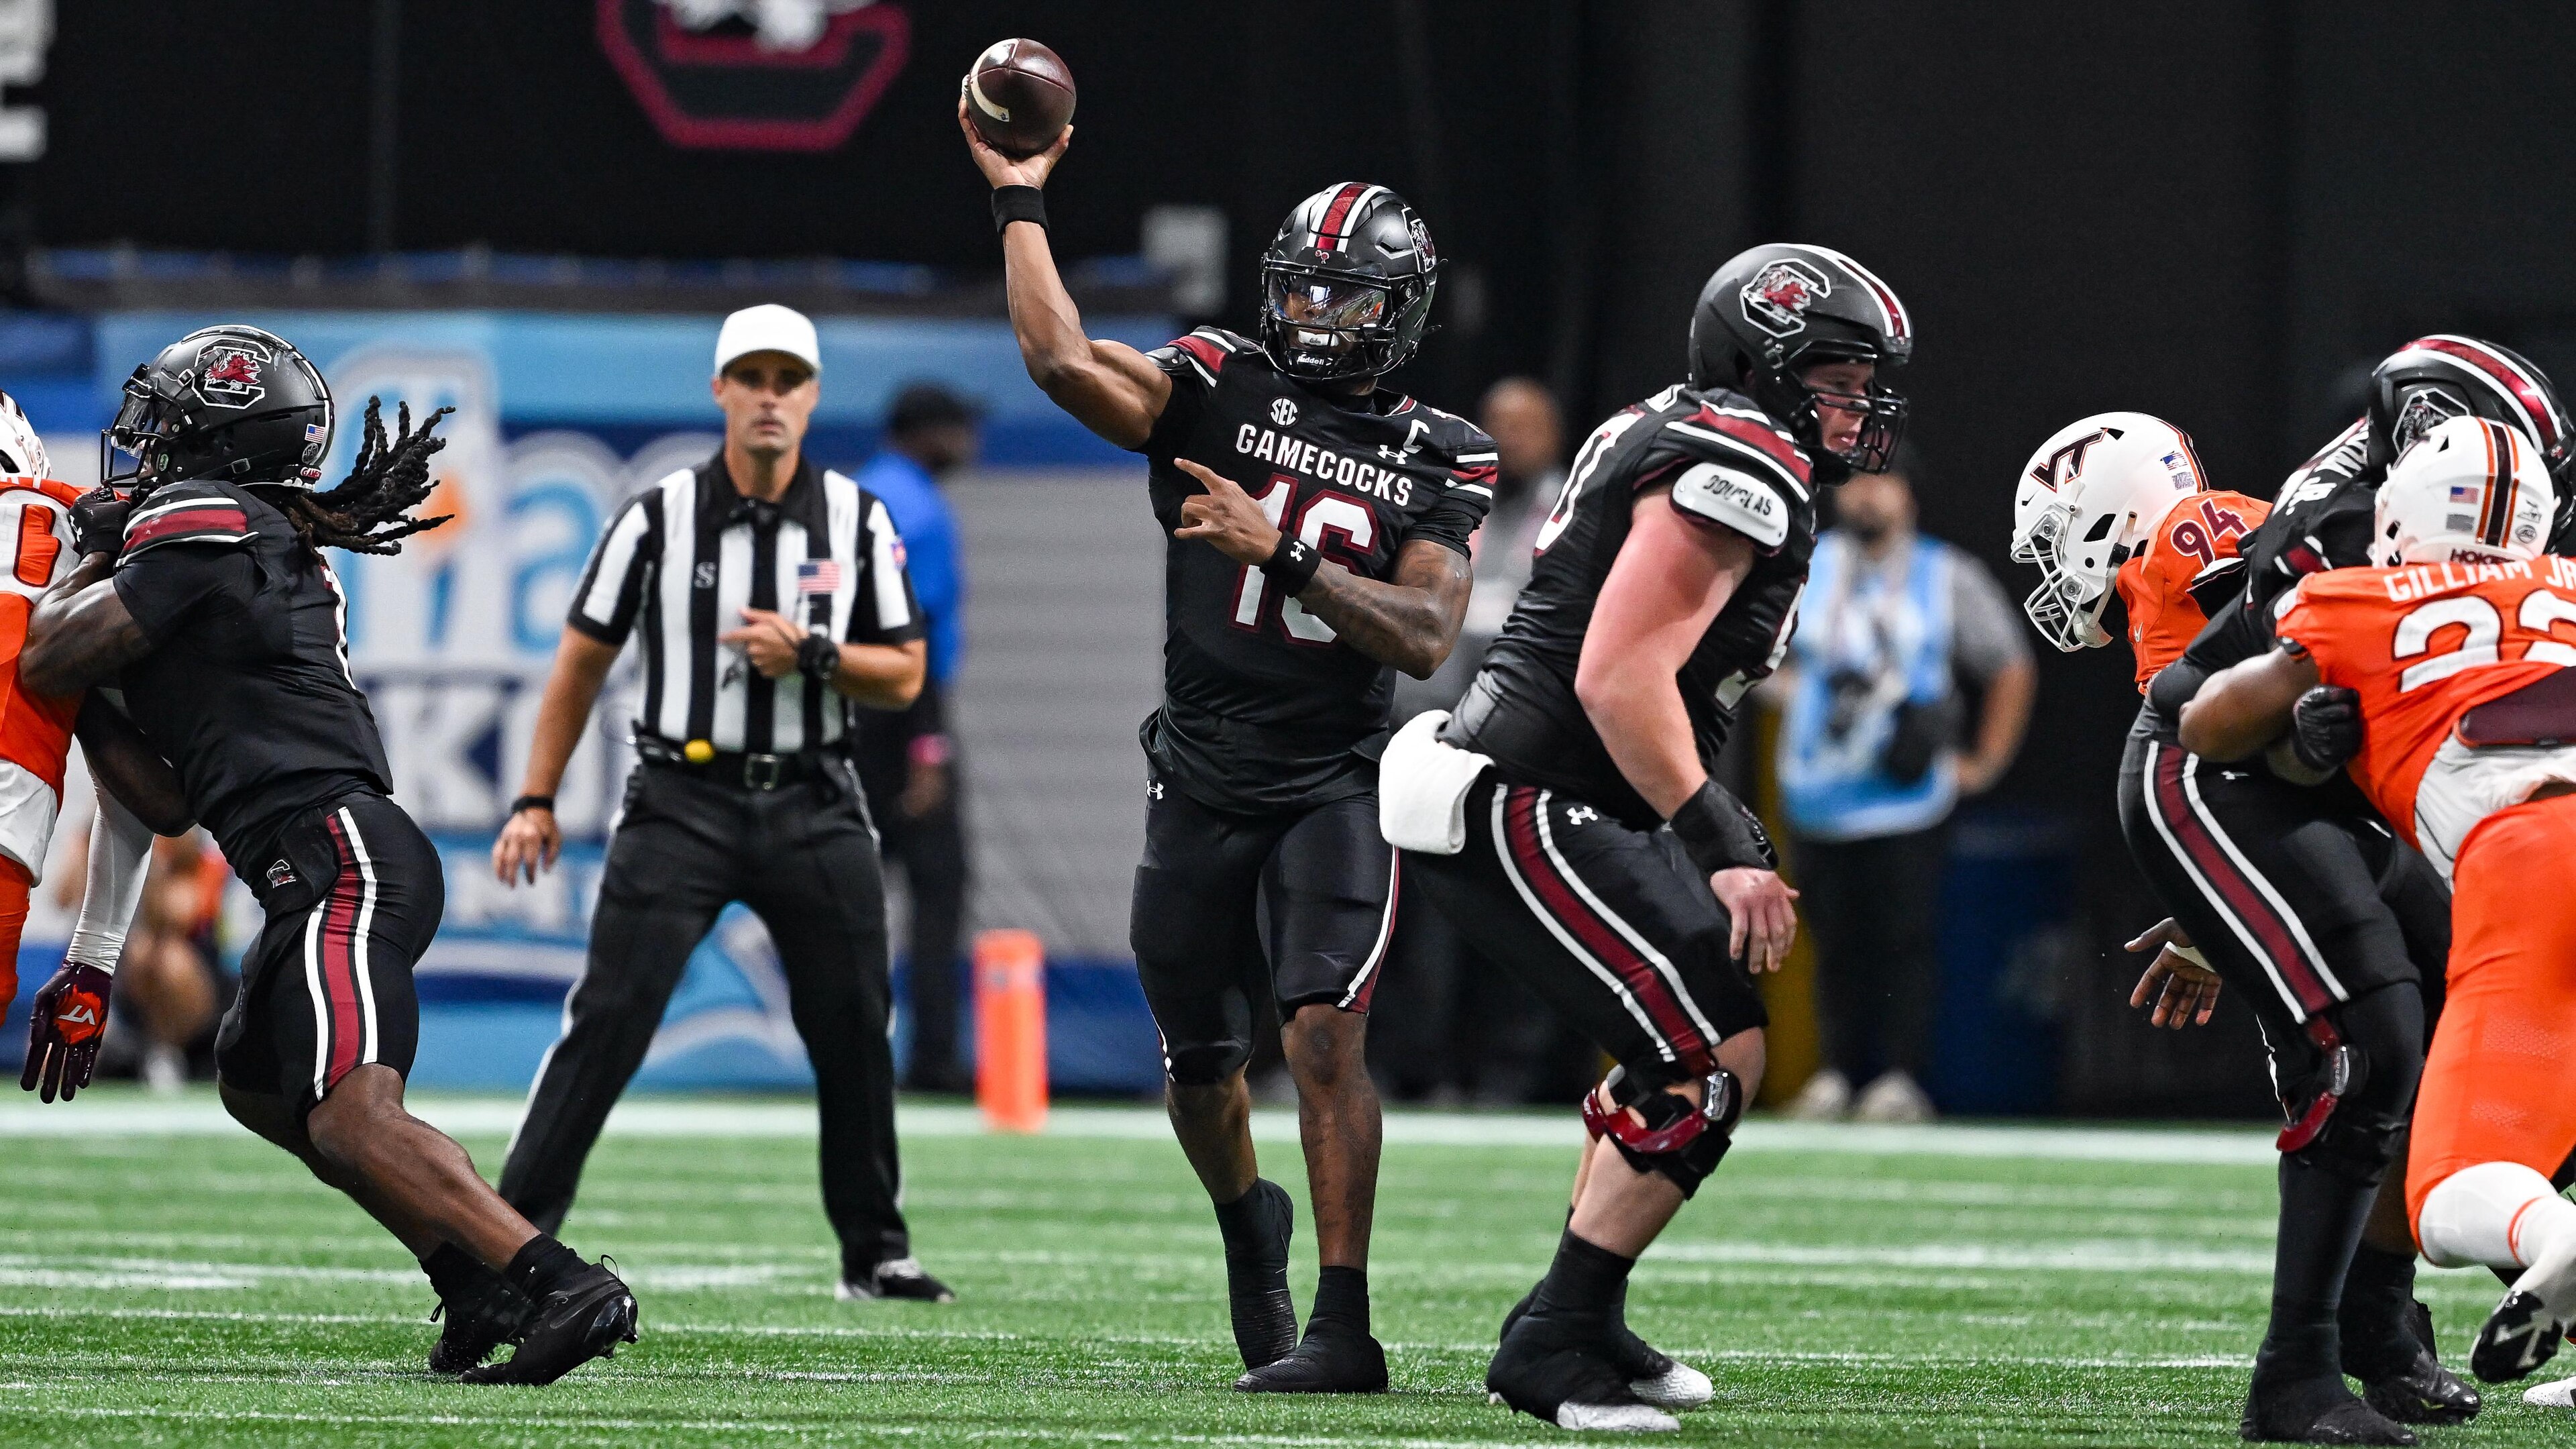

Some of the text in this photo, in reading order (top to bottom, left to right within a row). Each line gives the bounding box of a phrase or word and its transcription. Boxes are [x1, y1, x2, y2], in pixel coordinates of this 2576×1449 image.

[1270, 398, 1298, 426] SEC
[1403, 419, 1430, 454] C
[1236, 423, 1412, 506] GAMECOCKS
[1228, 472, 1380, 649] 16
[2169, 498, 2252, 571] 94
[2383, 559, 2533, 602] GILLIAM
